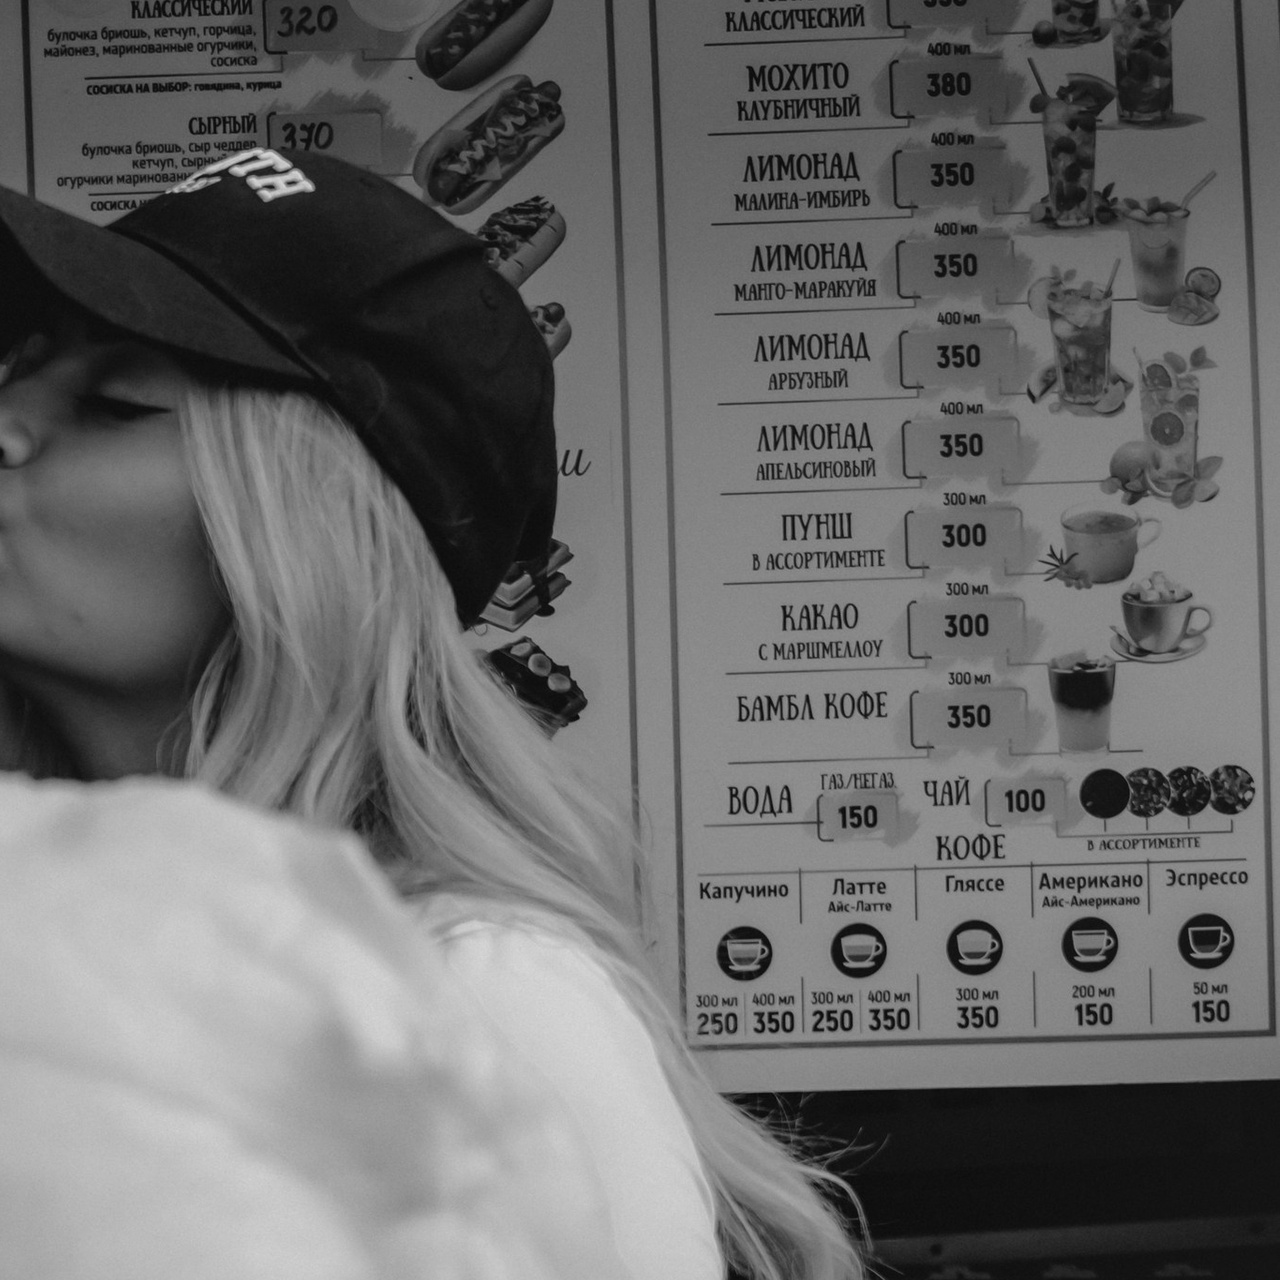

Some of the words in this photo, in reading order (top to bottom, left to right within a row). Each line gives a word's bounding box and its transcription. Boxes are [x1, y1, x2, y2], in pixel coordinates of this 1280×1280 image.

[277, 5, 337, 37] 320
[725, 4, 865, 32] КЛАССИЧЕСКИЙ
[47, 29, 98, 45] булочка
[101, 27, 150, 42] бриошь,
[154, 27, 199, 40] кетчуп,
[203, 24, 257, 38] горчица,
[44, 45, 99, 57] майонез,
[103, 43, 194, 57] маринованные
[197, 40, 257, 54] огурчики,
[928, 42, 954, 57] 400
[953, 44, 972, 56] мл
[211, 55, 258, 67] сосиска
[87, 84, 133, 95] СОСИСКА
[136, 83, 150, 93] НА
[152, 82, 191, 93] ВЫБОР:
[194, 82, 244, 91] говядина,
[246, 81, 282, 91] курица
[746, 62, 849, 92] МОХИТО
[927, 72, 971, 97] 380
[737, 94, 860, 121] КЛУБНИЧНЫЙ
[189, 113, 258, 135] СЫРНЫЙ
[280, 122, 333, 154] 370
[931, 132, 957, 147] 400
[957, 134, 975, 145] мл
[82, 143, 132, 159] булочка
[135, 141, 185, 157] бриошь,
[189, 142, 211, 154] сыр
[132, 158, 177, 171] кетчуп,
[743, 152, 860, 182] ЛИМОНАД
[931, 162, 974, 187] 350
[57, 176, 113, 189] огурчики
[90, 200, 137, 211] СОСИСКА
[734, 189, 870, 211] МАЛИНА-ИМБИРЬ
[934, 222, 959, 237] 400
[960, 225, 978, 235] мл
[751, 242, 867, 272] ЛИМОНАД
[934, 253, 977, 278] 350
[734, 277, 876, 301] МАНГО-МАРАКУЙЯ
[937, 311, 962, 326] 400
[963, 314, 981, 324] мл
[755, 332, 870, 362] ЛИМОНАД
[937, 344, 980, 368] 350
[769, 368, 848, 390] АРБУЗНЫЙ
[940, 402, 964, 415] 400
[966, 404, 983, 414] мл
[758, 422, 873, 452] ЛИМОНАД
[940, 433, 983, 457] 350
[756, 458, 876, 481] АПЕЛЬСИНОВЫЙ
[944, 492, 967, 506] 300
[969, 495, 986, 505] мл
[782, 513, 852, 541] ПУНШ
[943, 523, 986, 547] 300
[752, 554, 760, 571] В
[766, 549, 885, 570] АССОРТИМЕНТЕ
[946, 582, 969, 596] 300
[972, 585, 989, 595] мл
[781, 603, 858, 631] КАКАО
[945, 614, 989, 638] 300
[758, 644, 767, 660] С
[773, 640, 883, 660] МАРШМЕЛЛОУ
[949, 672, 972, 685] 300
[974, 674, 991, 685] мл
[738, 694, 814, 722] БАМБЛ
[824, 691, 887, 719] КОФЕ
[948, 705, 991, 728] 350
[728, 785, 792, 817] ВОДА
[924, 776, 970, 806] ЧАЙ
[1005, 789, 1045, 812] 100
[839, 805, 877, 828] 150
[936, 834, 1005, 860] КОФЕ
[1088, 840, 1094, 851] В
[1100, 837, 1200, 850] АССОРТИМЕНТЕ
[833, 878, 886, 895] Латте
[946, 875, 1004, 892] Гляссе
[1039, 873, 1143, 893] Американо
[1166, 869, 1248, 890] Эспрессо
[700, 882, 788, 903] Капучино
[1042, 896, 1140, 909] Айс-Американо
[828, 900, 892, 912] Айс-Латте
[752, 993, 775, 1006] 400
[779, 996, 794, 1005] мл
[812, 992, 834, 1005] 300
[837, 994, 853, 1003] мл
[868, 990, 891, 1003] 400
[894, 993, 910, 1002] мл
[956, 988, 979, 1001] 300
[983, 990, 999, 1000] мл
[1072, 985, 1095, 998] 200
[1099, 987, 1115, 997] мл
[1194, 982, 1208, 995] 50
[1212, 984, 1228, 994] мл
[696, 995, 718, 1008] 300
[722, 997, 738, 1006] мл
[1192, 1000, 1230, 1023] 150
[698, 1012, 738, 1035] 250
[754, 1011, 794, 1034] 350
[812, 1010, 853, 1032] 250
[869, 1008, 910, 1031] 350
[958, 1006, 998, 1029] 350
[1075, 1003, 1113, 1026] 150
